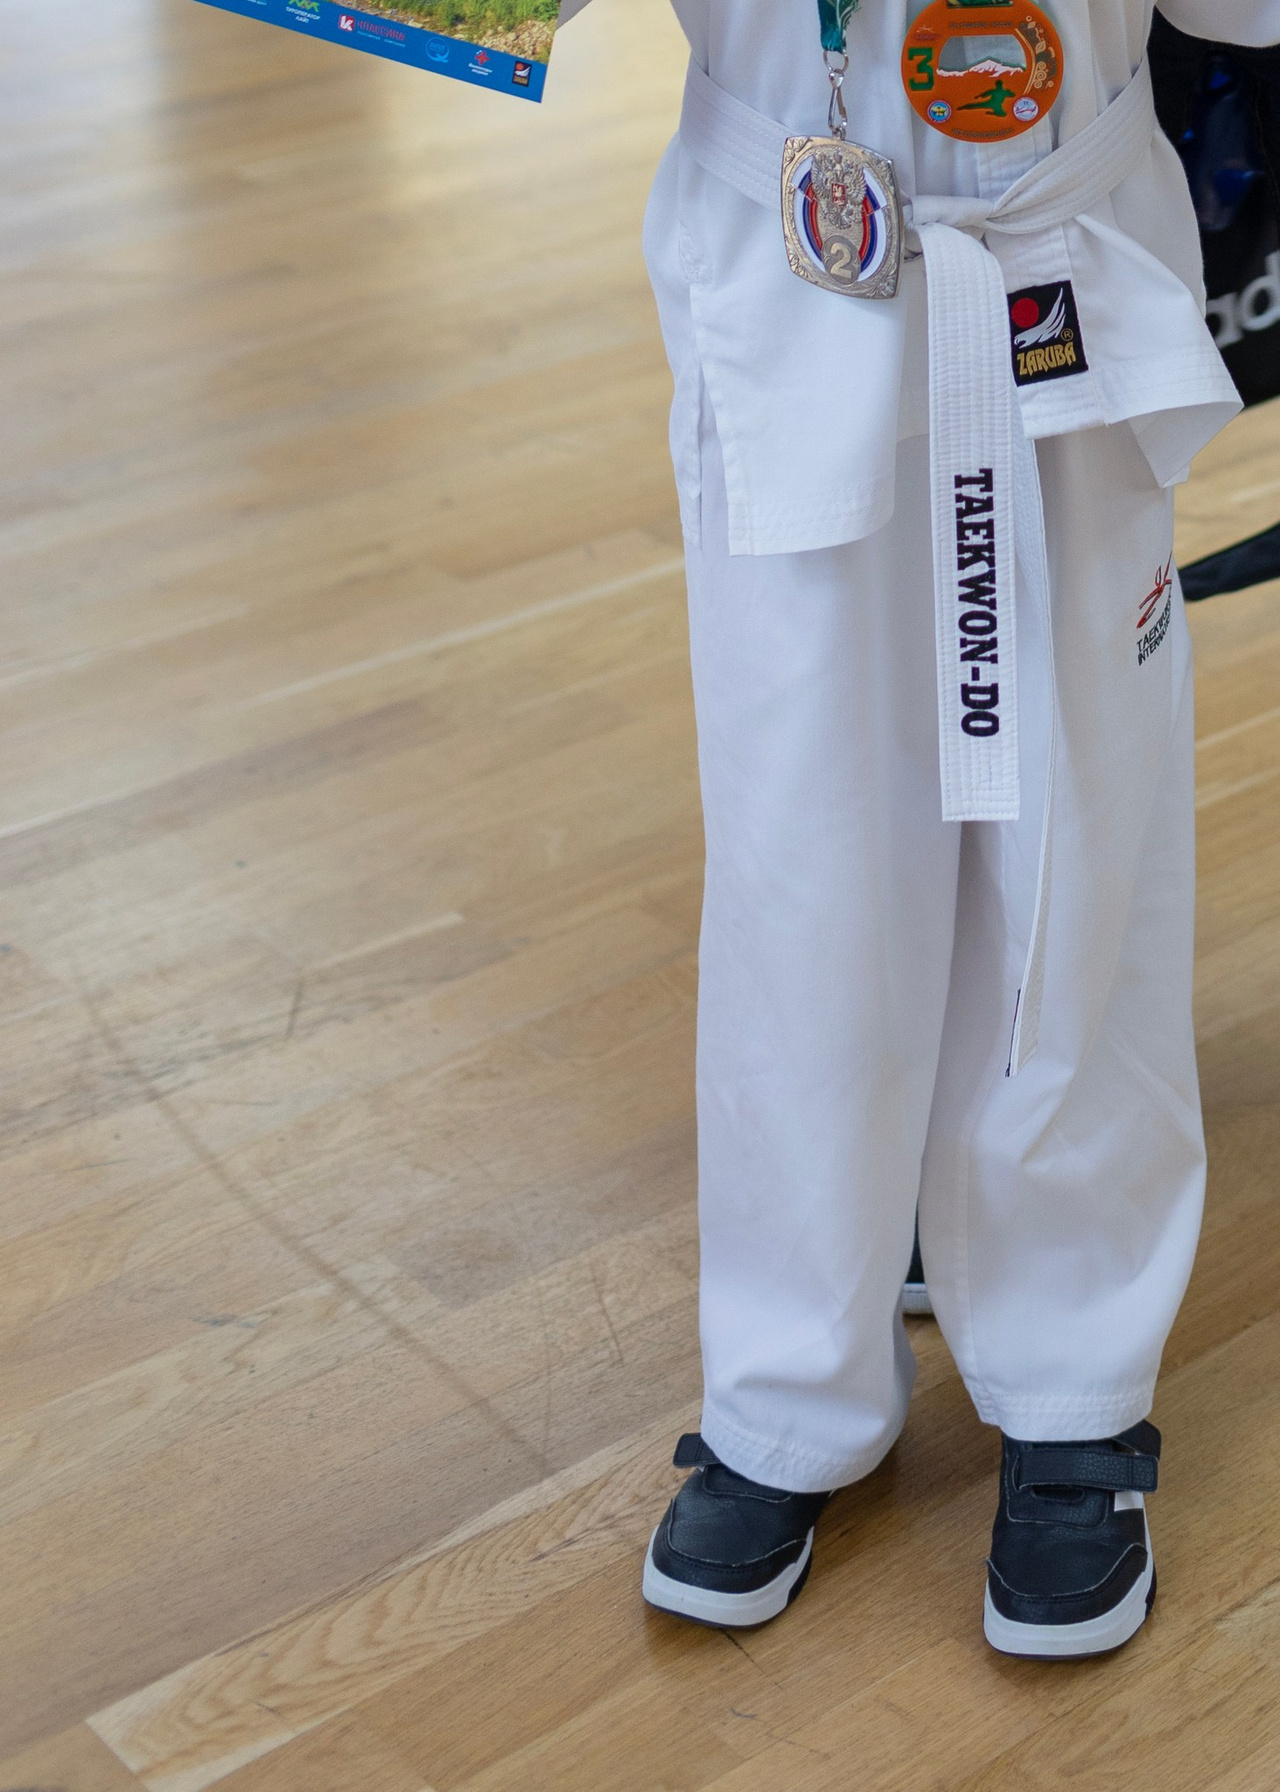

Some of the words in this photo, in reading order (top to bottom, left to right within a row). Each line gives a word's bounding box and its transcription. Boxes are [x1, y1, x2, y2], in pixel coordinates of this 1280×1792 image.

[284, 5, 321, 22] ТУРОПЕРАТОР
[908, 47, 935, 91] 3
[830, 242, 852, 280] 2
[1016, 341, 1077, 377] ZARUBA
[953, 467, 1000, 738] TAEKWON-DO
